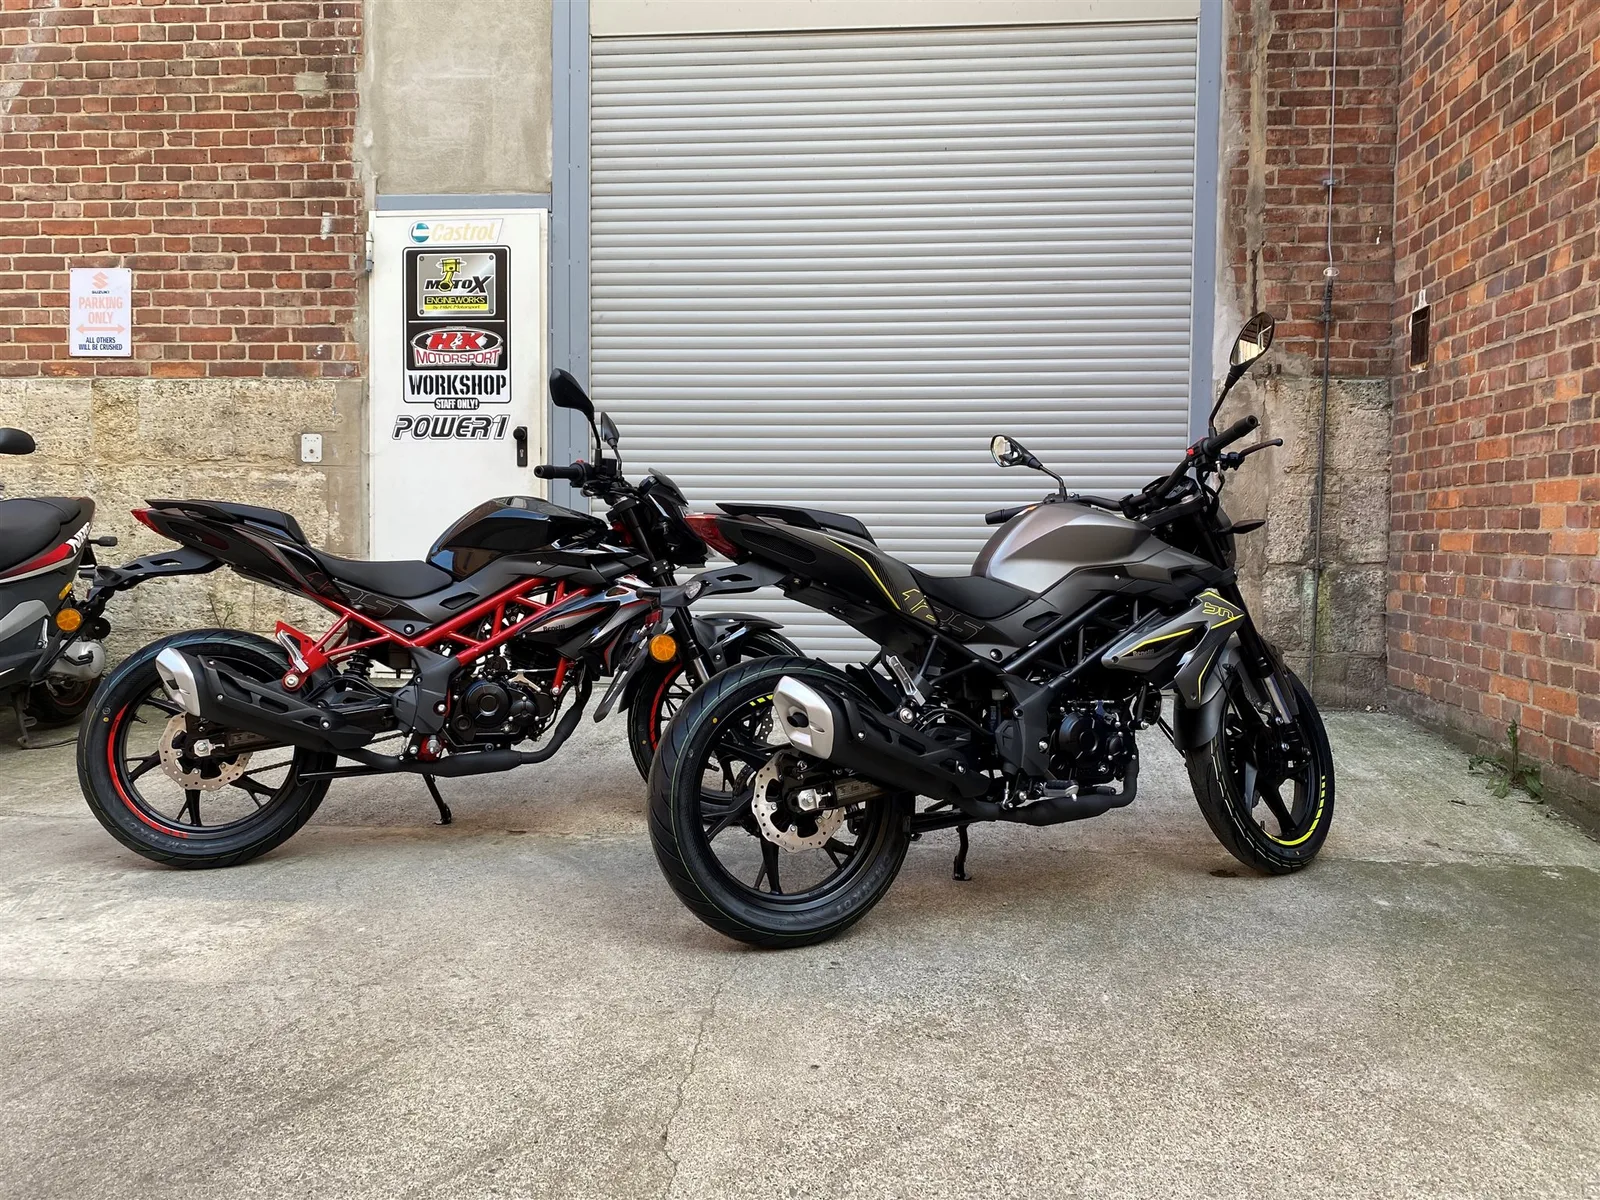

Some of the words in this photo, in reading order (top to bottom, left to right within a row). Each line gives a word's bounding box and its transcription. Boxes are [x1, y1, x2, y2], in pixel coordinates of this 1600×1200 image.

[431, 222, 496, 241] Castrol
[78, 296, 123, 309] PARKING
[426, 296, 486, 304] ENGINEWORKS
[88, 311, 114, 324] ONLY
[85, 336, 95, 344] ALL
[96, 336, 116, 344] OTHERS
[427, 332, 484, 350] H&K
[78, 343, 91, 351] WILL
[91, 343, 98, 351] BE
[99, 343, 123, 351] CRUSHED
[415, 349, 500, 364] MOTORSPORT
[408, 374, 507, 396] WORKSHOP
[435, 399, 456, 409] STAFF
[456, 399, 478, 409] ONLY!
[393, 415, 509, 439] POWER1
[542, 623, 566, 632] Benelli
[1132, 648, 1155, 657] Benelli
